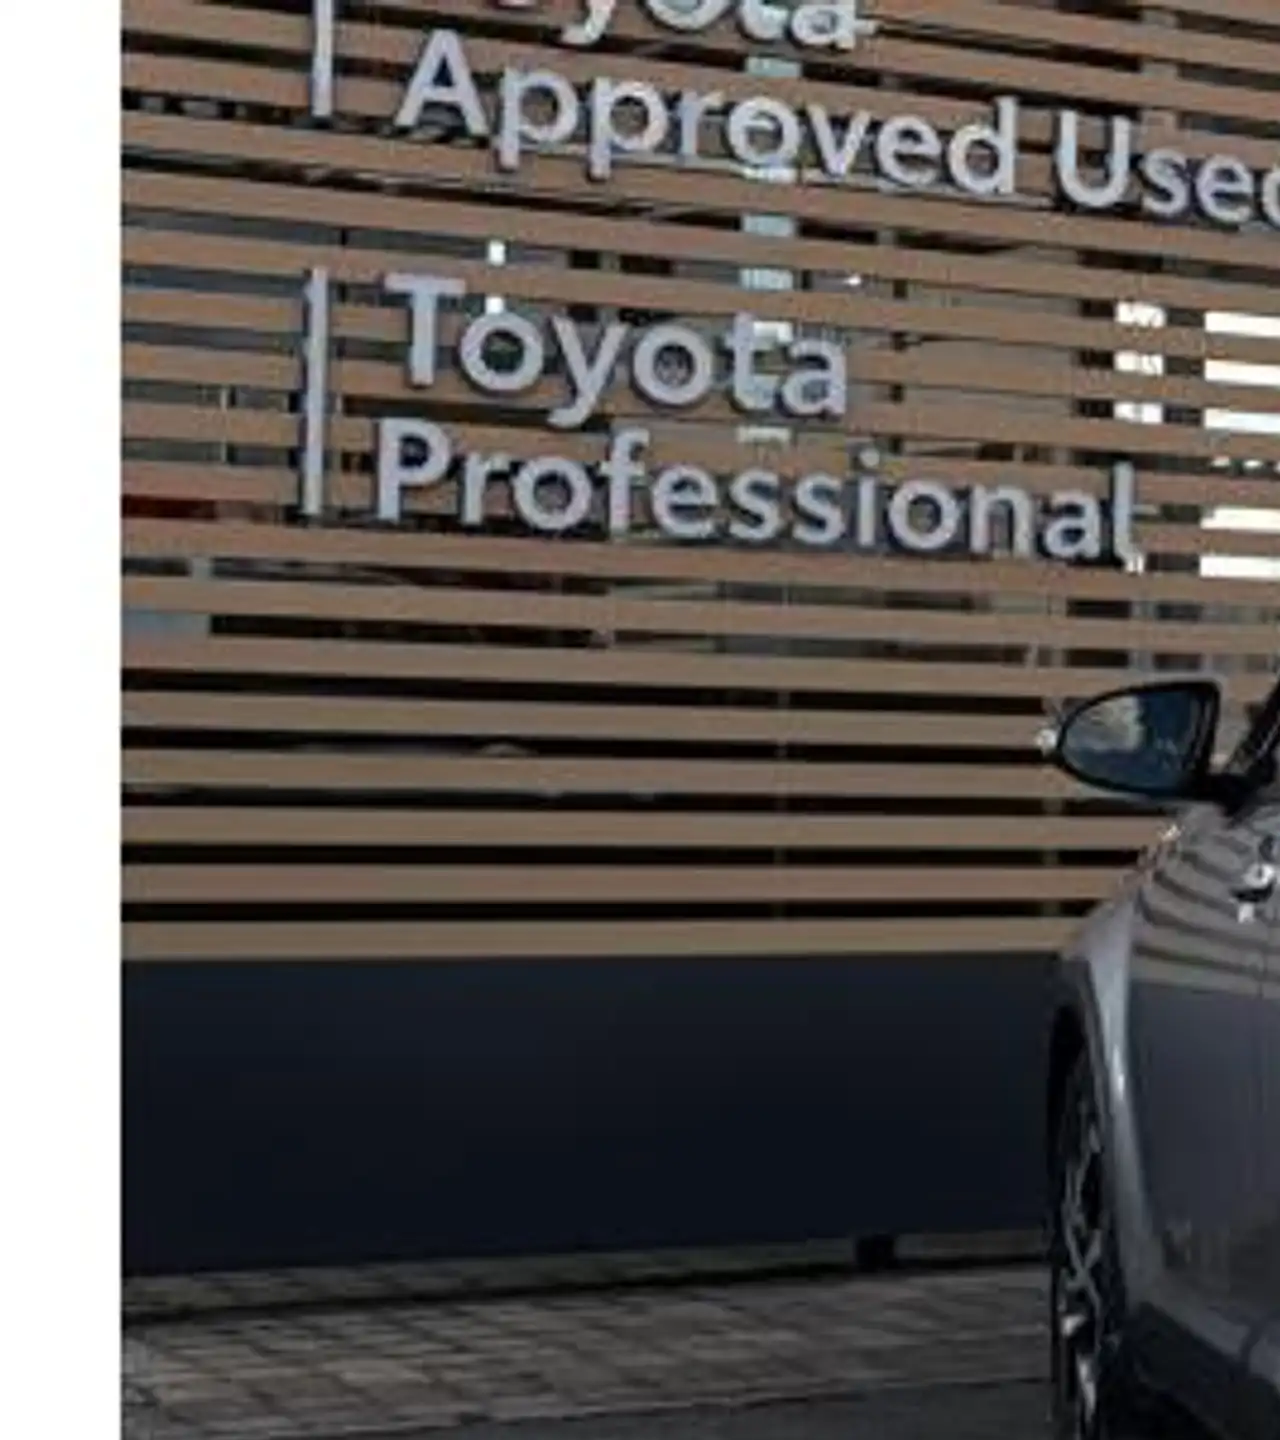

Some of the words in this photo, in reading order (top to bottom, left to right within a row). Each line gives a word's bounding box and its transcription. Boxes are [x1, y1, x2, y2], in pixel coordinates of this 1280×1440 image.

[395, 28, 1017, 194] Approved
[384, 284, 847, 429] Toyota
[373, 416, 1141, 566] Professional
